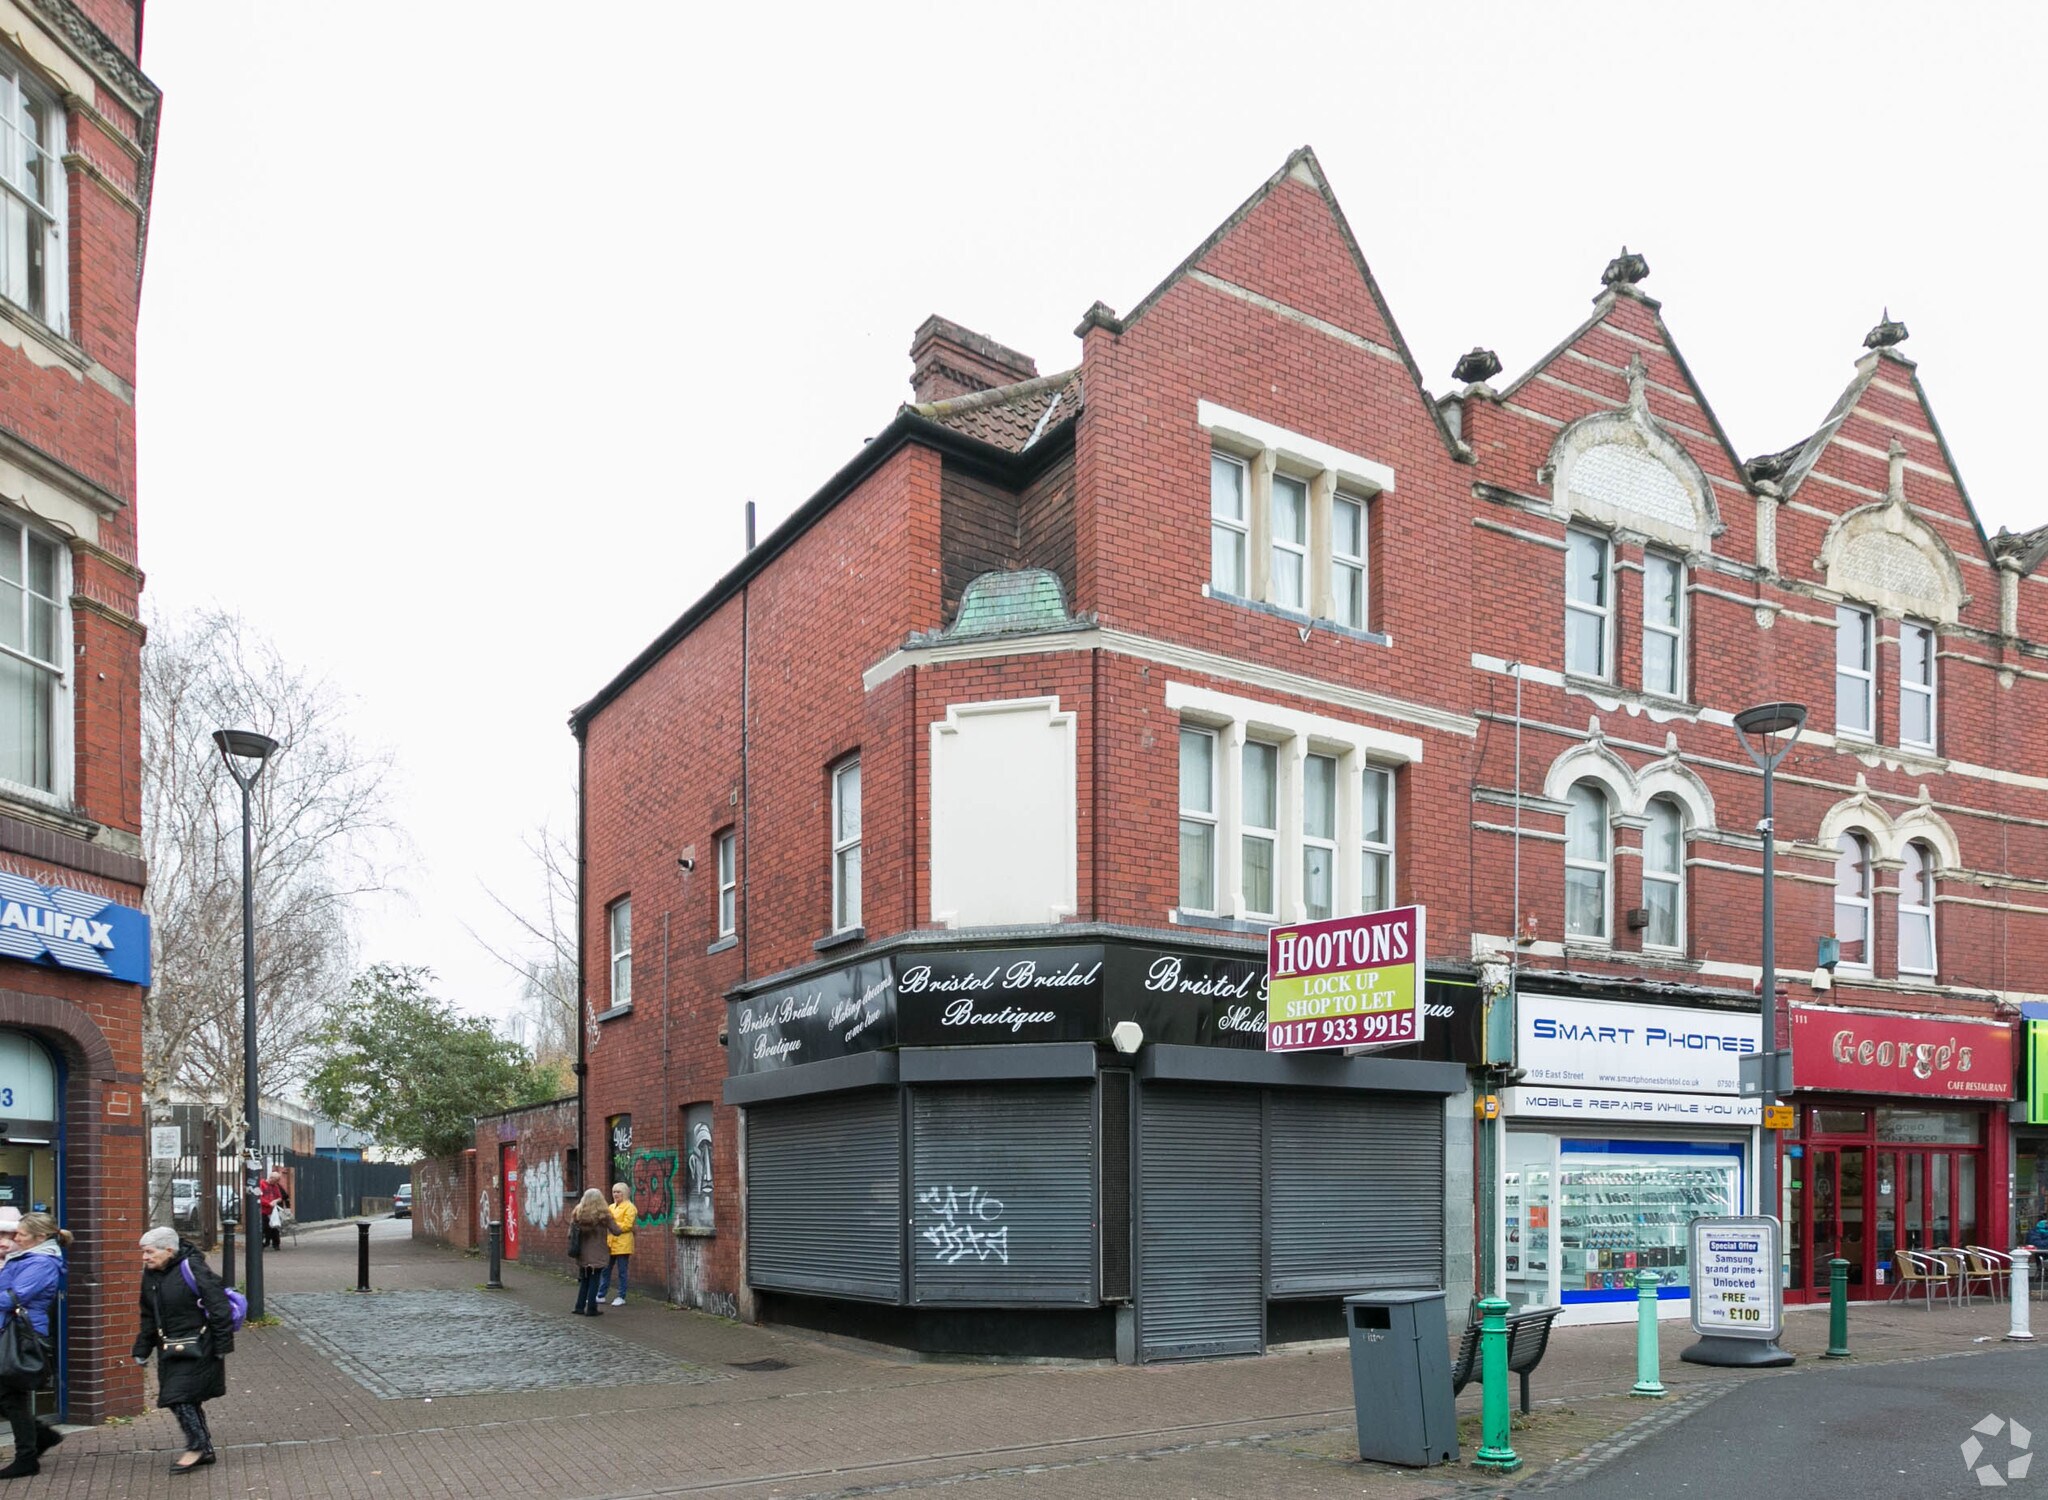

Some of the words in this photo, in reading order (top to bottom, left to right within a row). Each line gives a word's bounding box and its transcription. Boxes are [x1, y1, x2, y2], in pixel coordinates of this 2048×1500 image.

[1275, 920, 1409, 977] HOOTONS
[899, 966, 1000, 993] Bristol
[1002, 960, 1103, 989] Bridal
[1144, 956, 1255, 999] Bristol
[1303, 974, 1352, 997] LOCK
[1356, 971, 1380, 990] UP
[738, 1003, 779, 1035] Bristol
[778, 992, 822, 1025] Bridal
[941, 999, 1056, 1032] Boutique
[1286, 995, 1334, 1019] SHOP
[1333, 994, 1357, 1013] TO
[1360, 990, 1396, 1010] LET
[1271, 1020, 1318, 1047] 0117
[1322, 1018, 1358, 1043] 933
[1362, 1012, 1413, 1040] 9915
[1533, 1018, 1635, 1044] SMART
[1646, 1027, 1755, 1053] PHONES
[753, 1033, 802, 1062] Boutique
[1832, 1030, 1974, 1080] George's
[1531, 1069, 1544, 1079] 109
[1545, 1070, 1562, 1080] East
[1562, 1071, 1584, 1081] Street
[1599, 1073, 1700, 1088] www.smartphonesbristol.co.uk
[1947, 1080, 1965, 1092] CAFE
[1965, 1081, 2008, 1093] RESTAURANT
[1525, 1096, 1584, 1109] MOBILE
[1589, 1099, 1653, 1112] REPAIRS
[1657, 1102, 1699, 1114] WHILE
[1705, 1105, 1732, 1115] YOU
[1711, 1241, 1737, 1252] Special
[1738, 1241, 1758, 1251] Offer
[1705, 1266, 1729, 1275] grand
[1715, 1254, 1754, 1266] Samsung
[1713, 1277, 1756, 1289] Unlocked
[1722, 1292, 1746, 1303] FREE
[1729, 1307, 1760, 1321] £100
